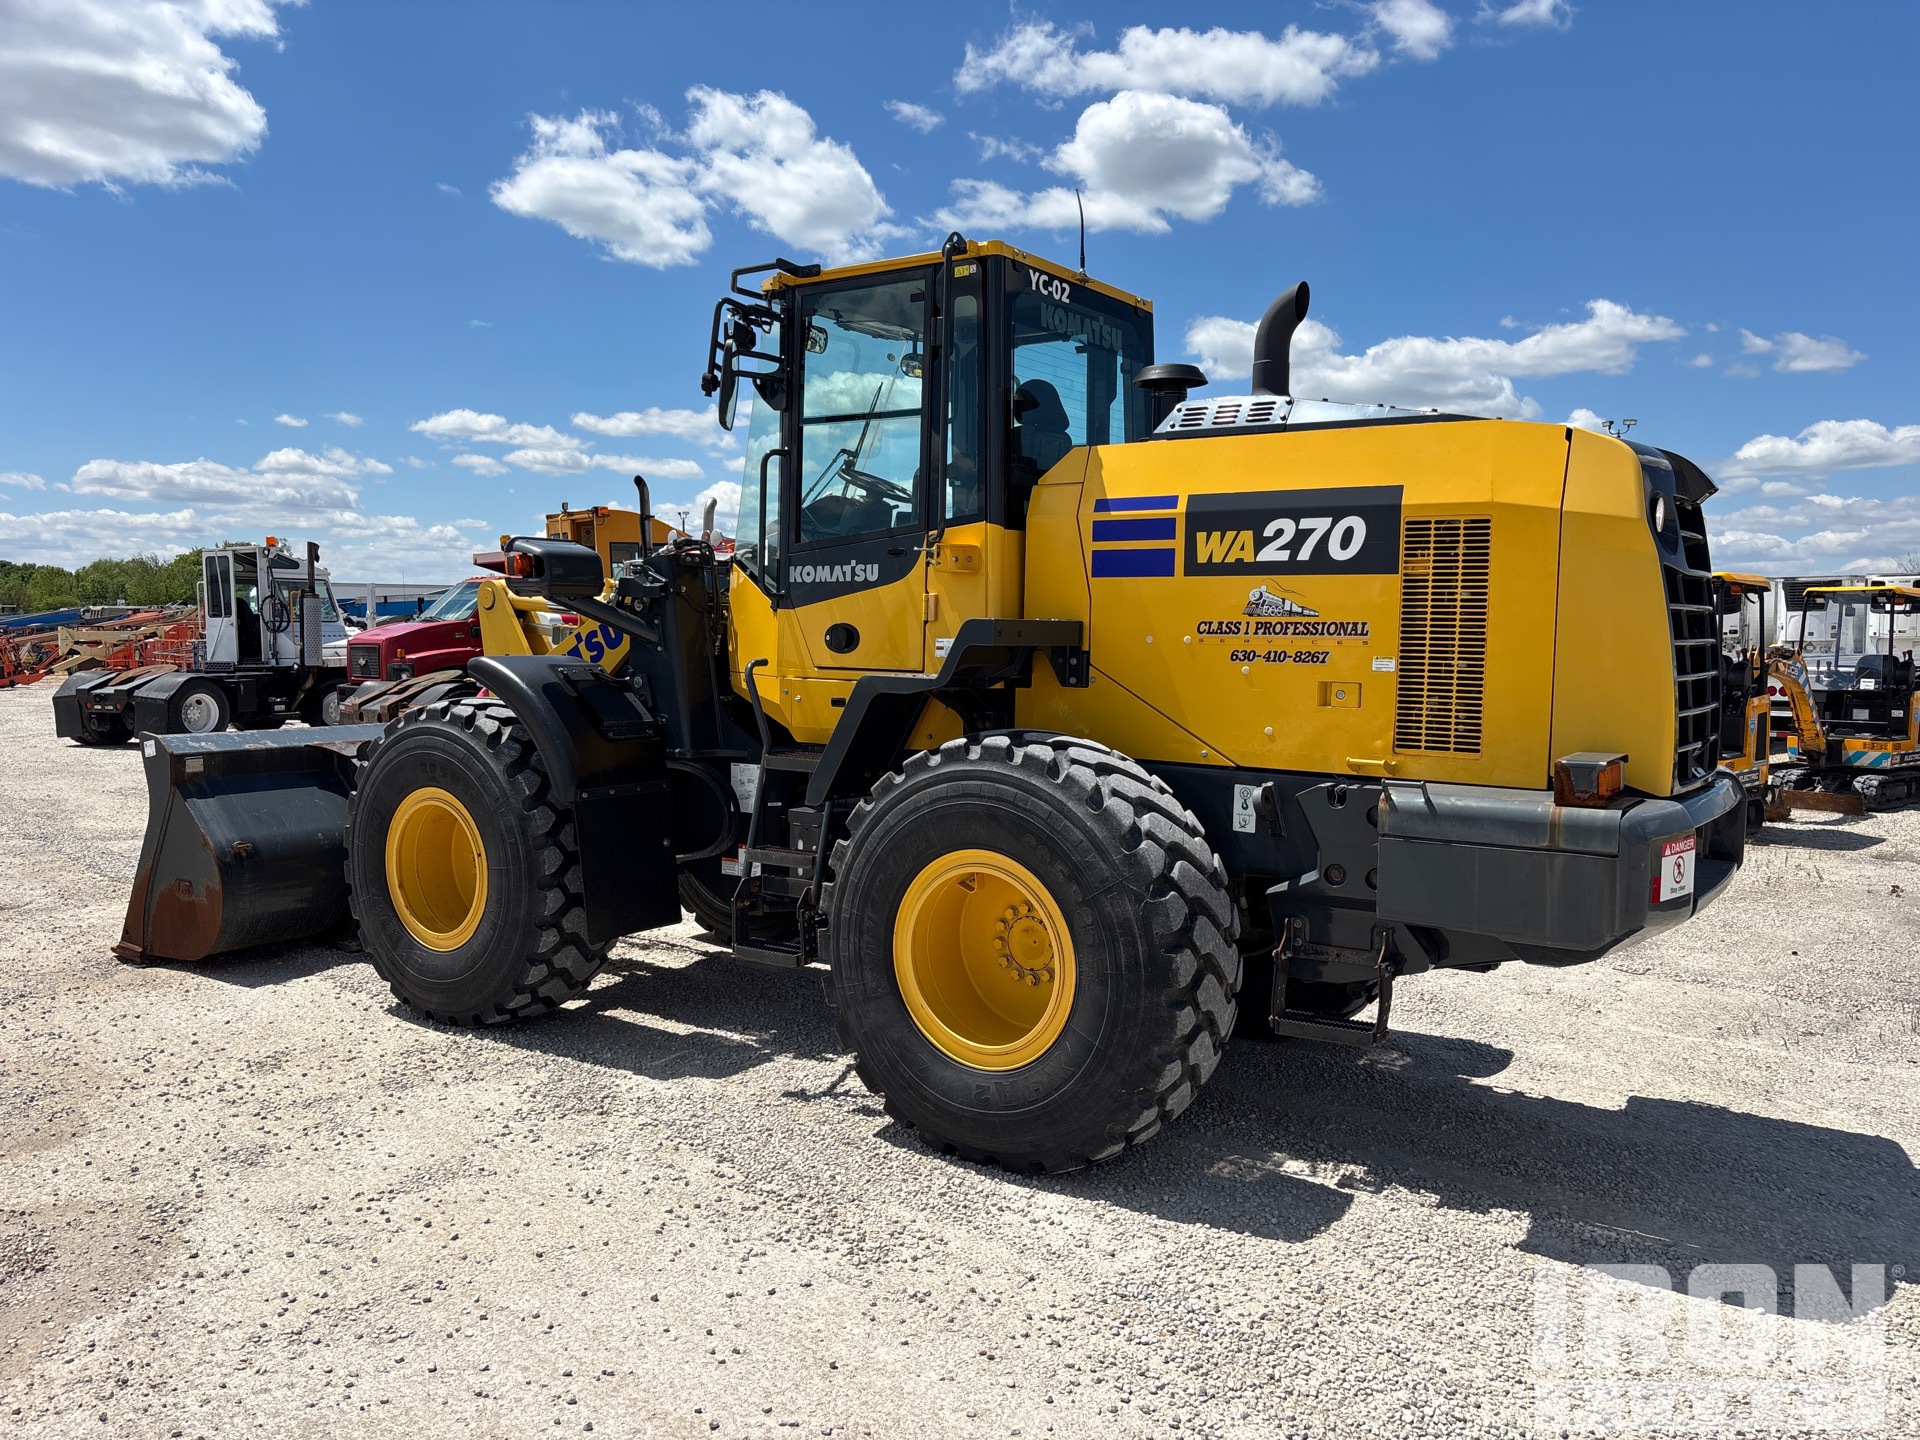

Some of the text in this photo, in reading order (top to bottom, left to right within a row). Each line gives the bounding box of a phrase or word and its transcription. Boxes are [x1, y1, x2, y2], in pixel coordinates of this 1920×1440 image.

[1029, 269, 1070, 304] YC-02
[1040, 302, 1123, 352] KOMATSU
[789, 560, 879, 583] KOMATSU
[1197, 620, 1370, 637] CLASS 1 PROFESSIONAL
[1198, 638, 1369, 646] SERVICES
[1230, 649, 1330, 664] 630-410-8267
[1787, 665, 1799, 676] JCB
[1672, 839, 1694, 853] DANGER
